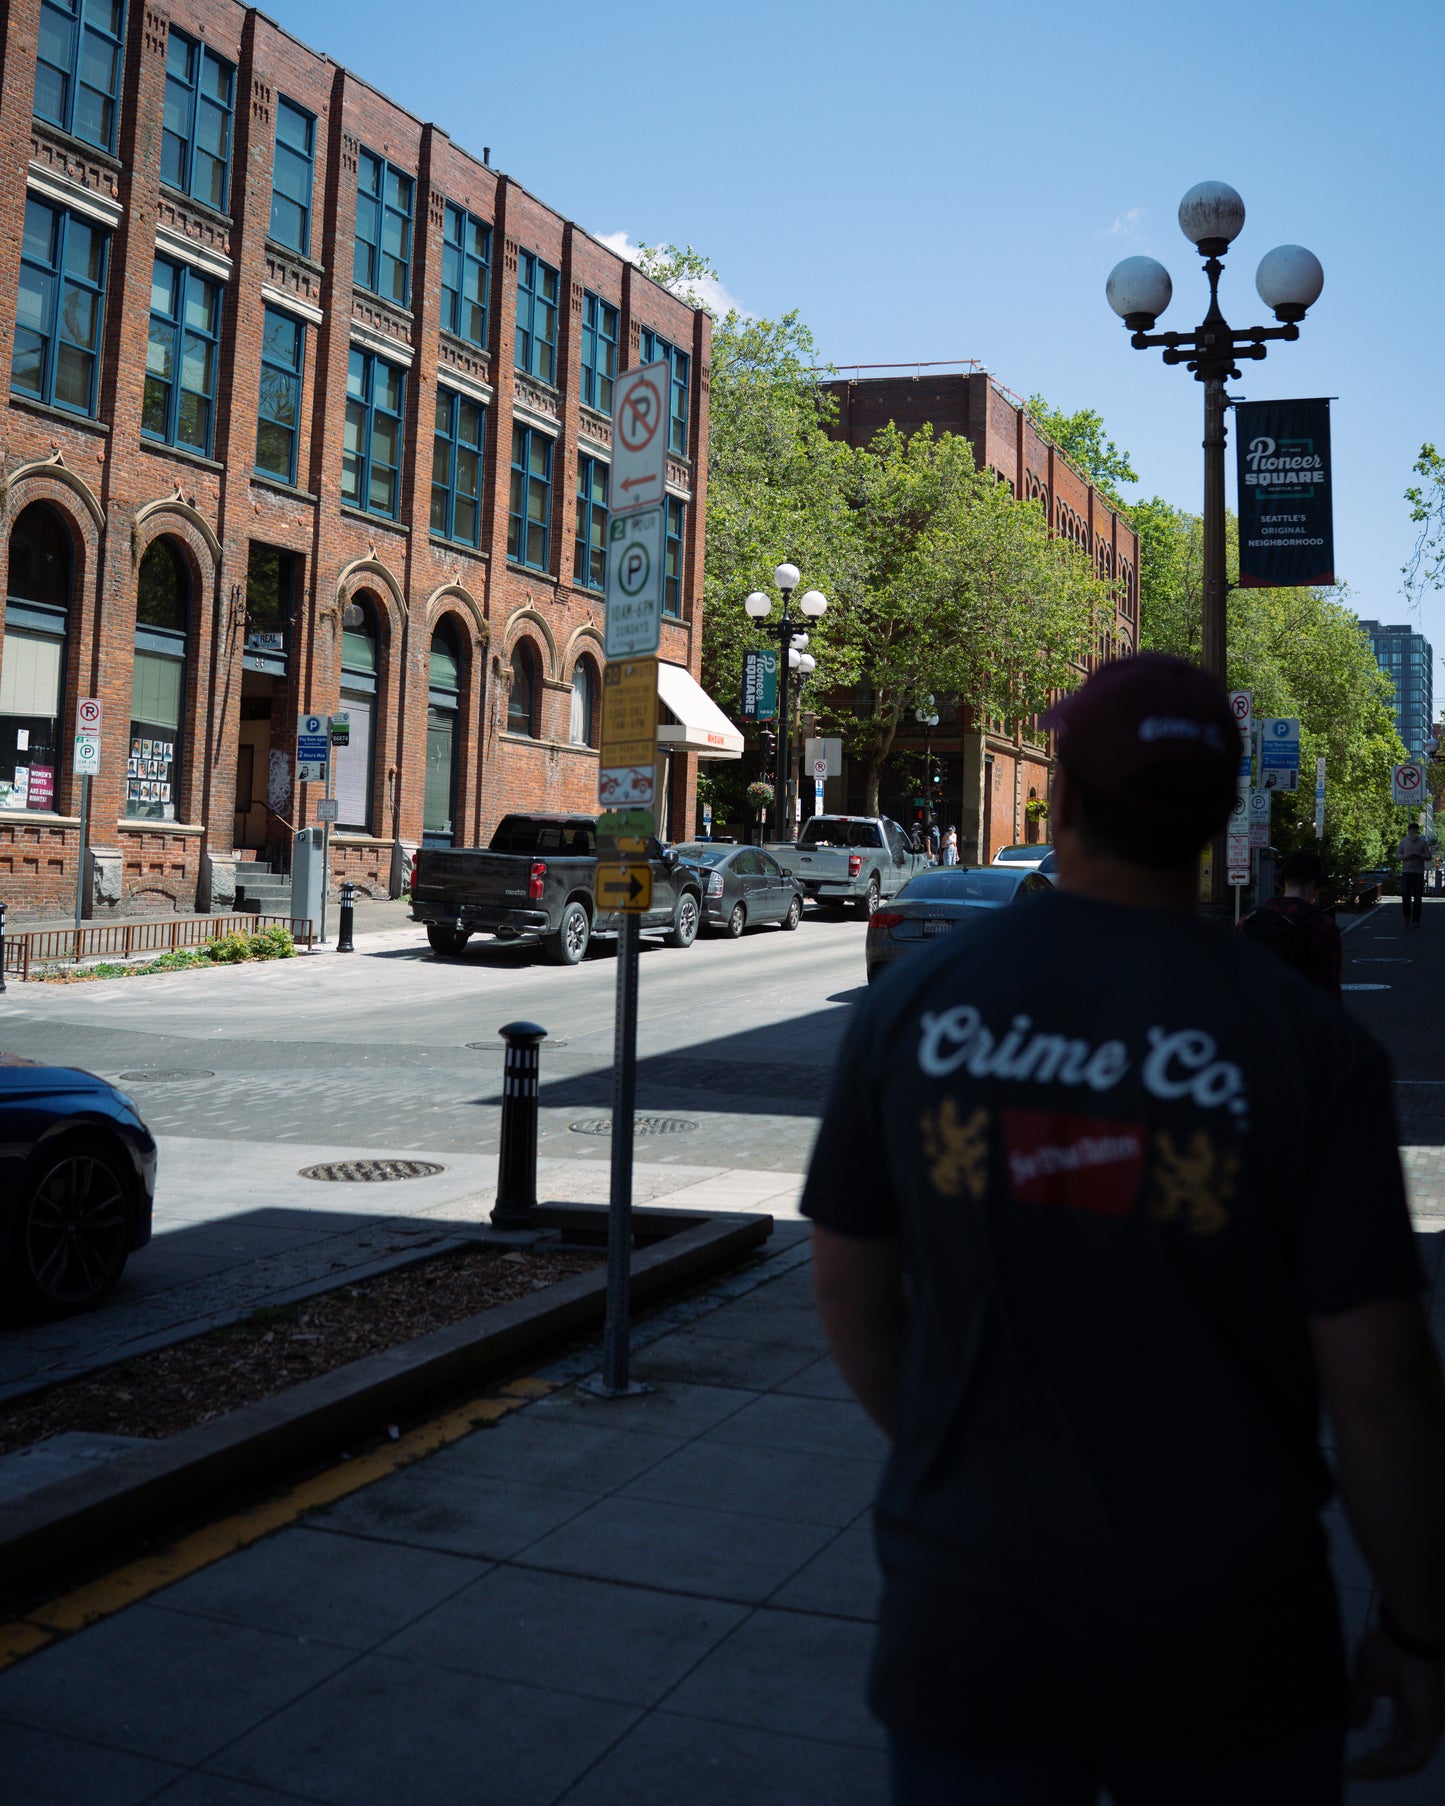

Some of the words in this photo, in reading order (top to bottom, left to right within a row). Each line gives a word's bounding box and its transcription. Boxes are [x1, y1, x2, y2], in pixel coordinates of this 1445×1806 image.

[1246, 436, 1323, 470] Pioneer
[1244, 470, 1324, 486] SQUARE
[1261, 514, 1306, 523] SEATTLE'S
[613, 519, 624, 540] 2
[1261, 526, 1306, 535] ORIGINAL
[1248, 538, 1324, 547] NEIGHBORHOOD
[627, 554, 643, 586] P
[616, 620, 650, 638] SUNDAYS
[260, 634, 277, 643] REAL
[624, 663, 654, 679] MNUTE
[756, 654, 777, 702] Pioneer
[745, 654, 757, 714] SQUARE
[310, 720, 318, 731] P
[1277, 724, 1287, 735] P
[84, 747, 92, 756] P
[298, 750, 304, 758] 2
[1264, 756, 1270, 765] 2
[31, 770, 53, 779] WOMEN'S
[31, 777, 47, 786] RIGHTS
[40, 788, 54, 796] EQUAL
[29, 795, 47, 803] RIGHTS!
[917, 1004, 1131, 1092] Crime
